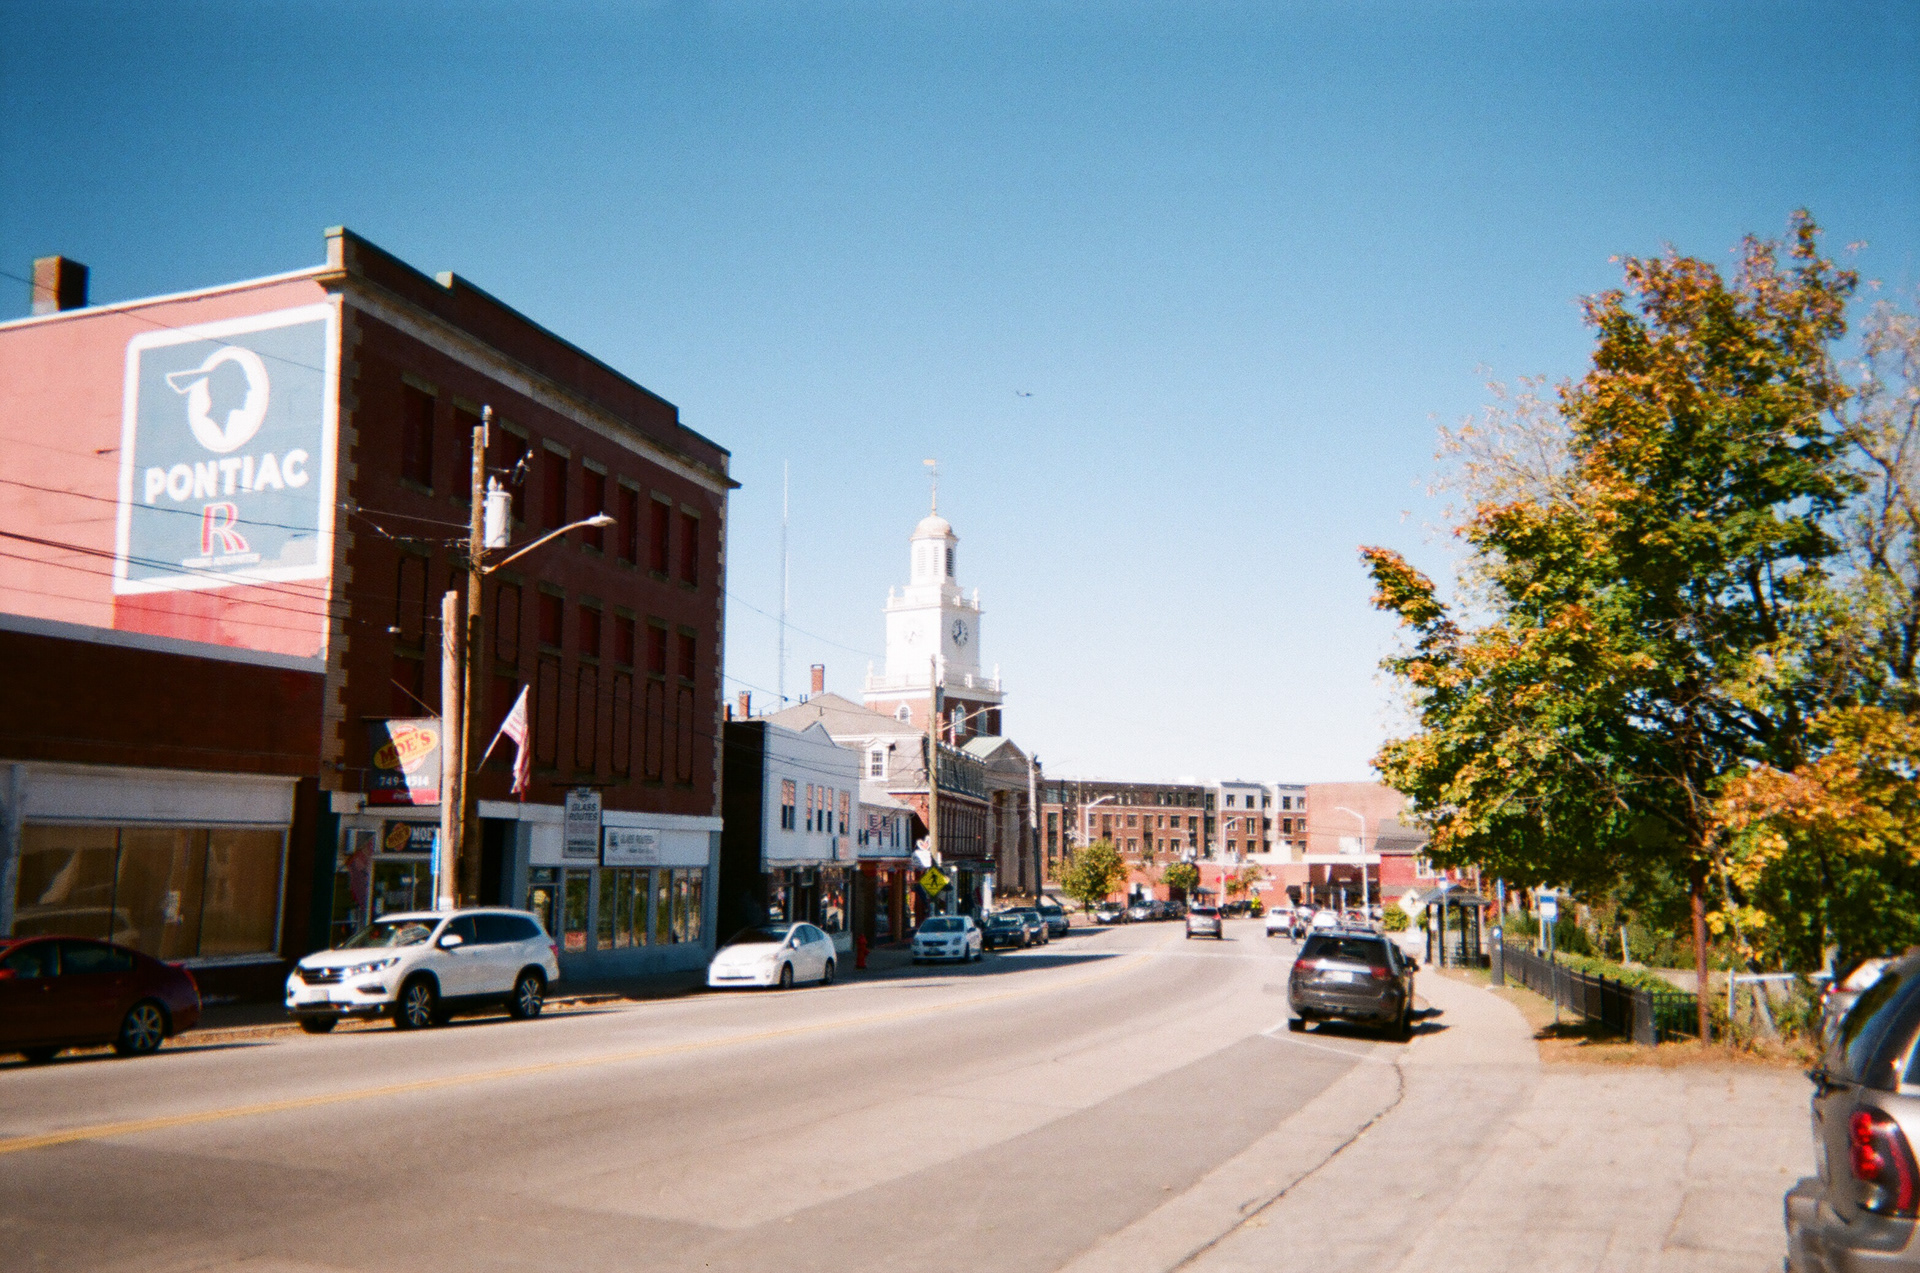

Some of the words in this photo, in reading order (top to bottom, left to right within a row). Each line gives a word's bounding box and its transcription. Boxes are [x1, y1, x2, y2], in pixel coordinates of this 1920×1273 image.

[144, 449, 309, 504] PONTIAC
[201, 502, 250, 556] R
[379, 731, 431, 764] MOE'S
[569, 812, 598, 821] ROUTES
[571, 803, 597, 812] GLASS
[411, 825, 437, 841] MOE'
